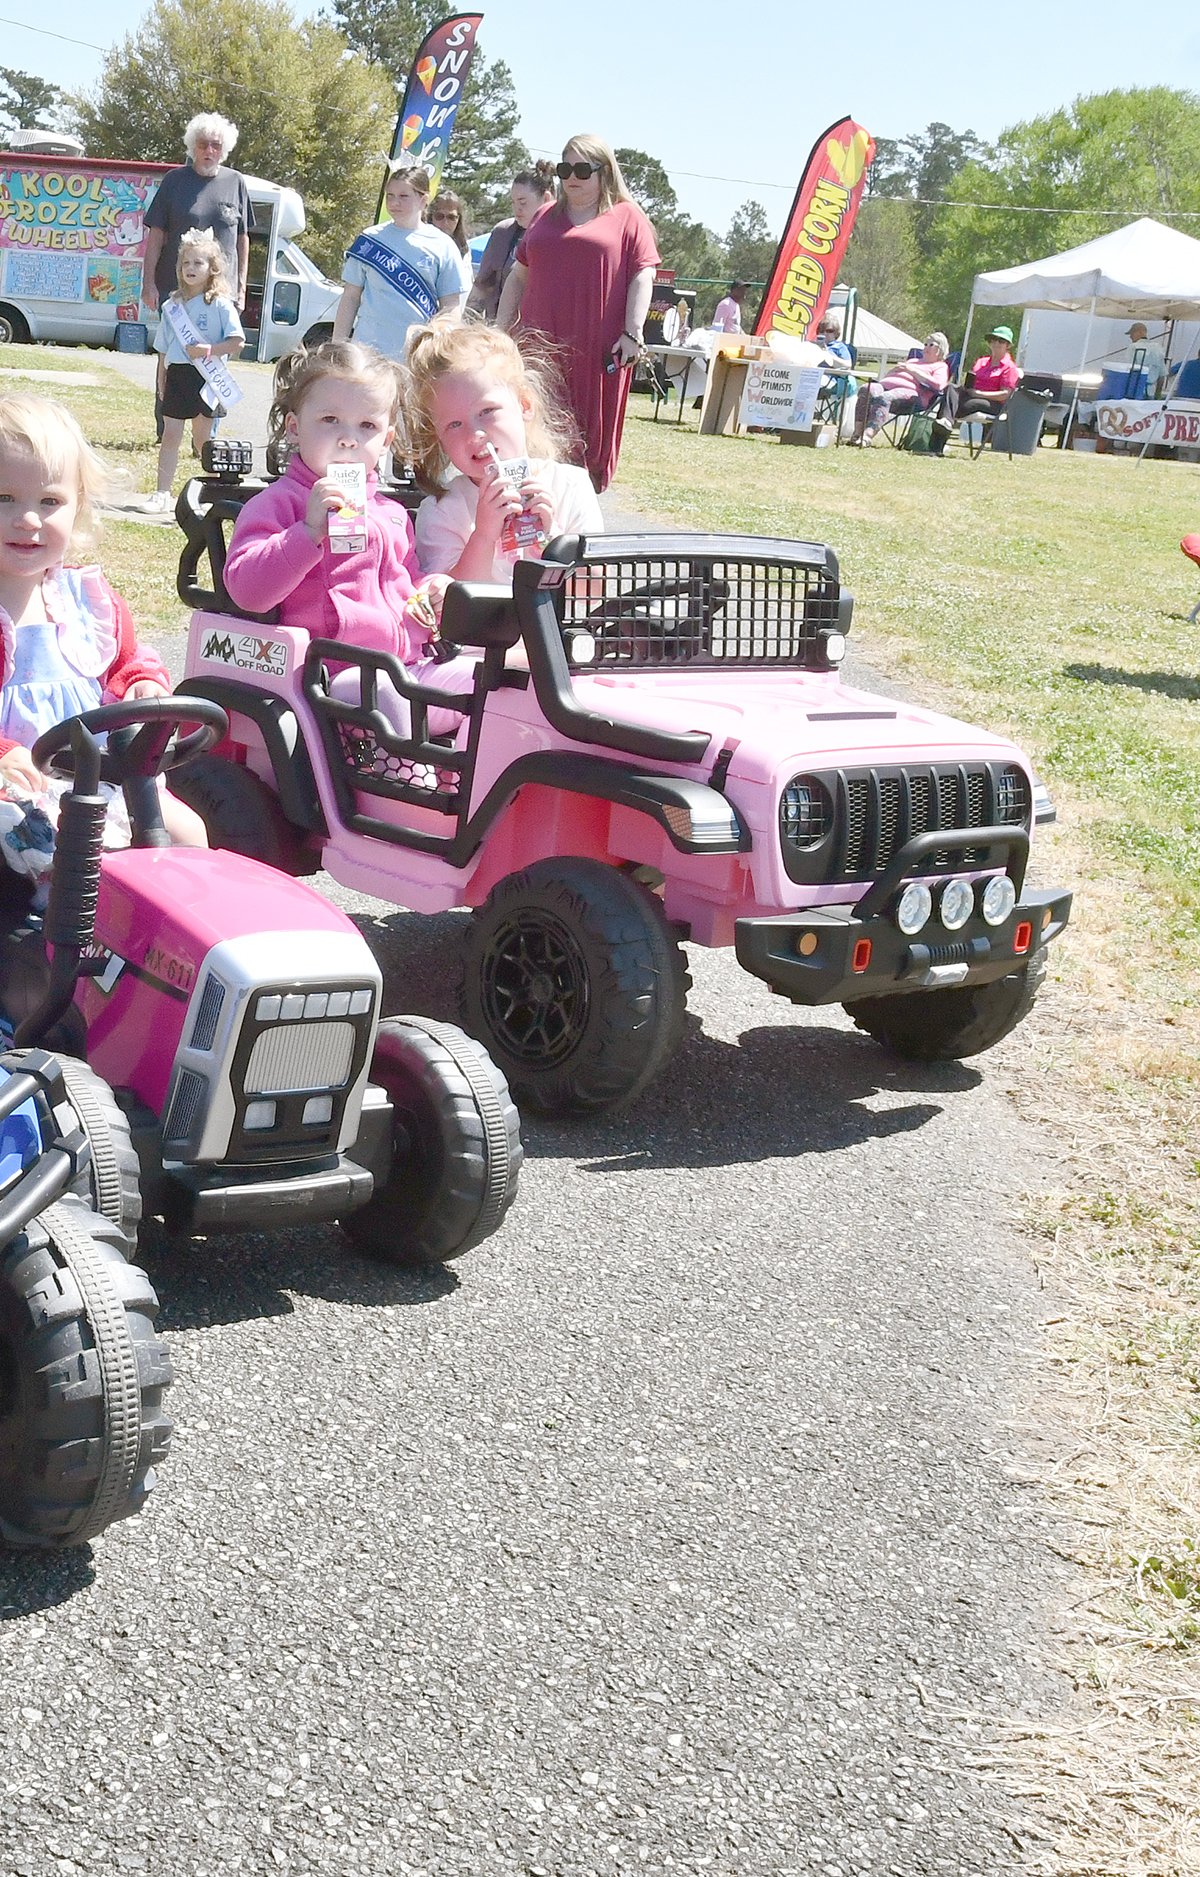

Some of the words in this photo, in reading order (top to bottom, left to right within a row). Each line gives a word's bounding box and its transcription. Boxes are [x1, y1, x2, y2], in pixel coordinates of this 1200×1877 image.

[425, 22, 472, 128] SNOW
[20, 172, 105, 202] KOOL
[8, 223, 110, 249] WHEELS
[372, 250, 399, 272] MISS
[765, 254, 826, 343] ASTED
[797, 176, 852, 255] CORN
[748, 375, 793, 393] OPTIMISTS
[751, 363, 791, 380] WELCOME
[747, 388, 794, 408] WORLDWIDE
[1123, 411, 1160, 437] SOFT
[238, 636, 288, 666] 4X4
[237, 659, 255, 670] OFF
[255, 662, 285, 676] ROAD
